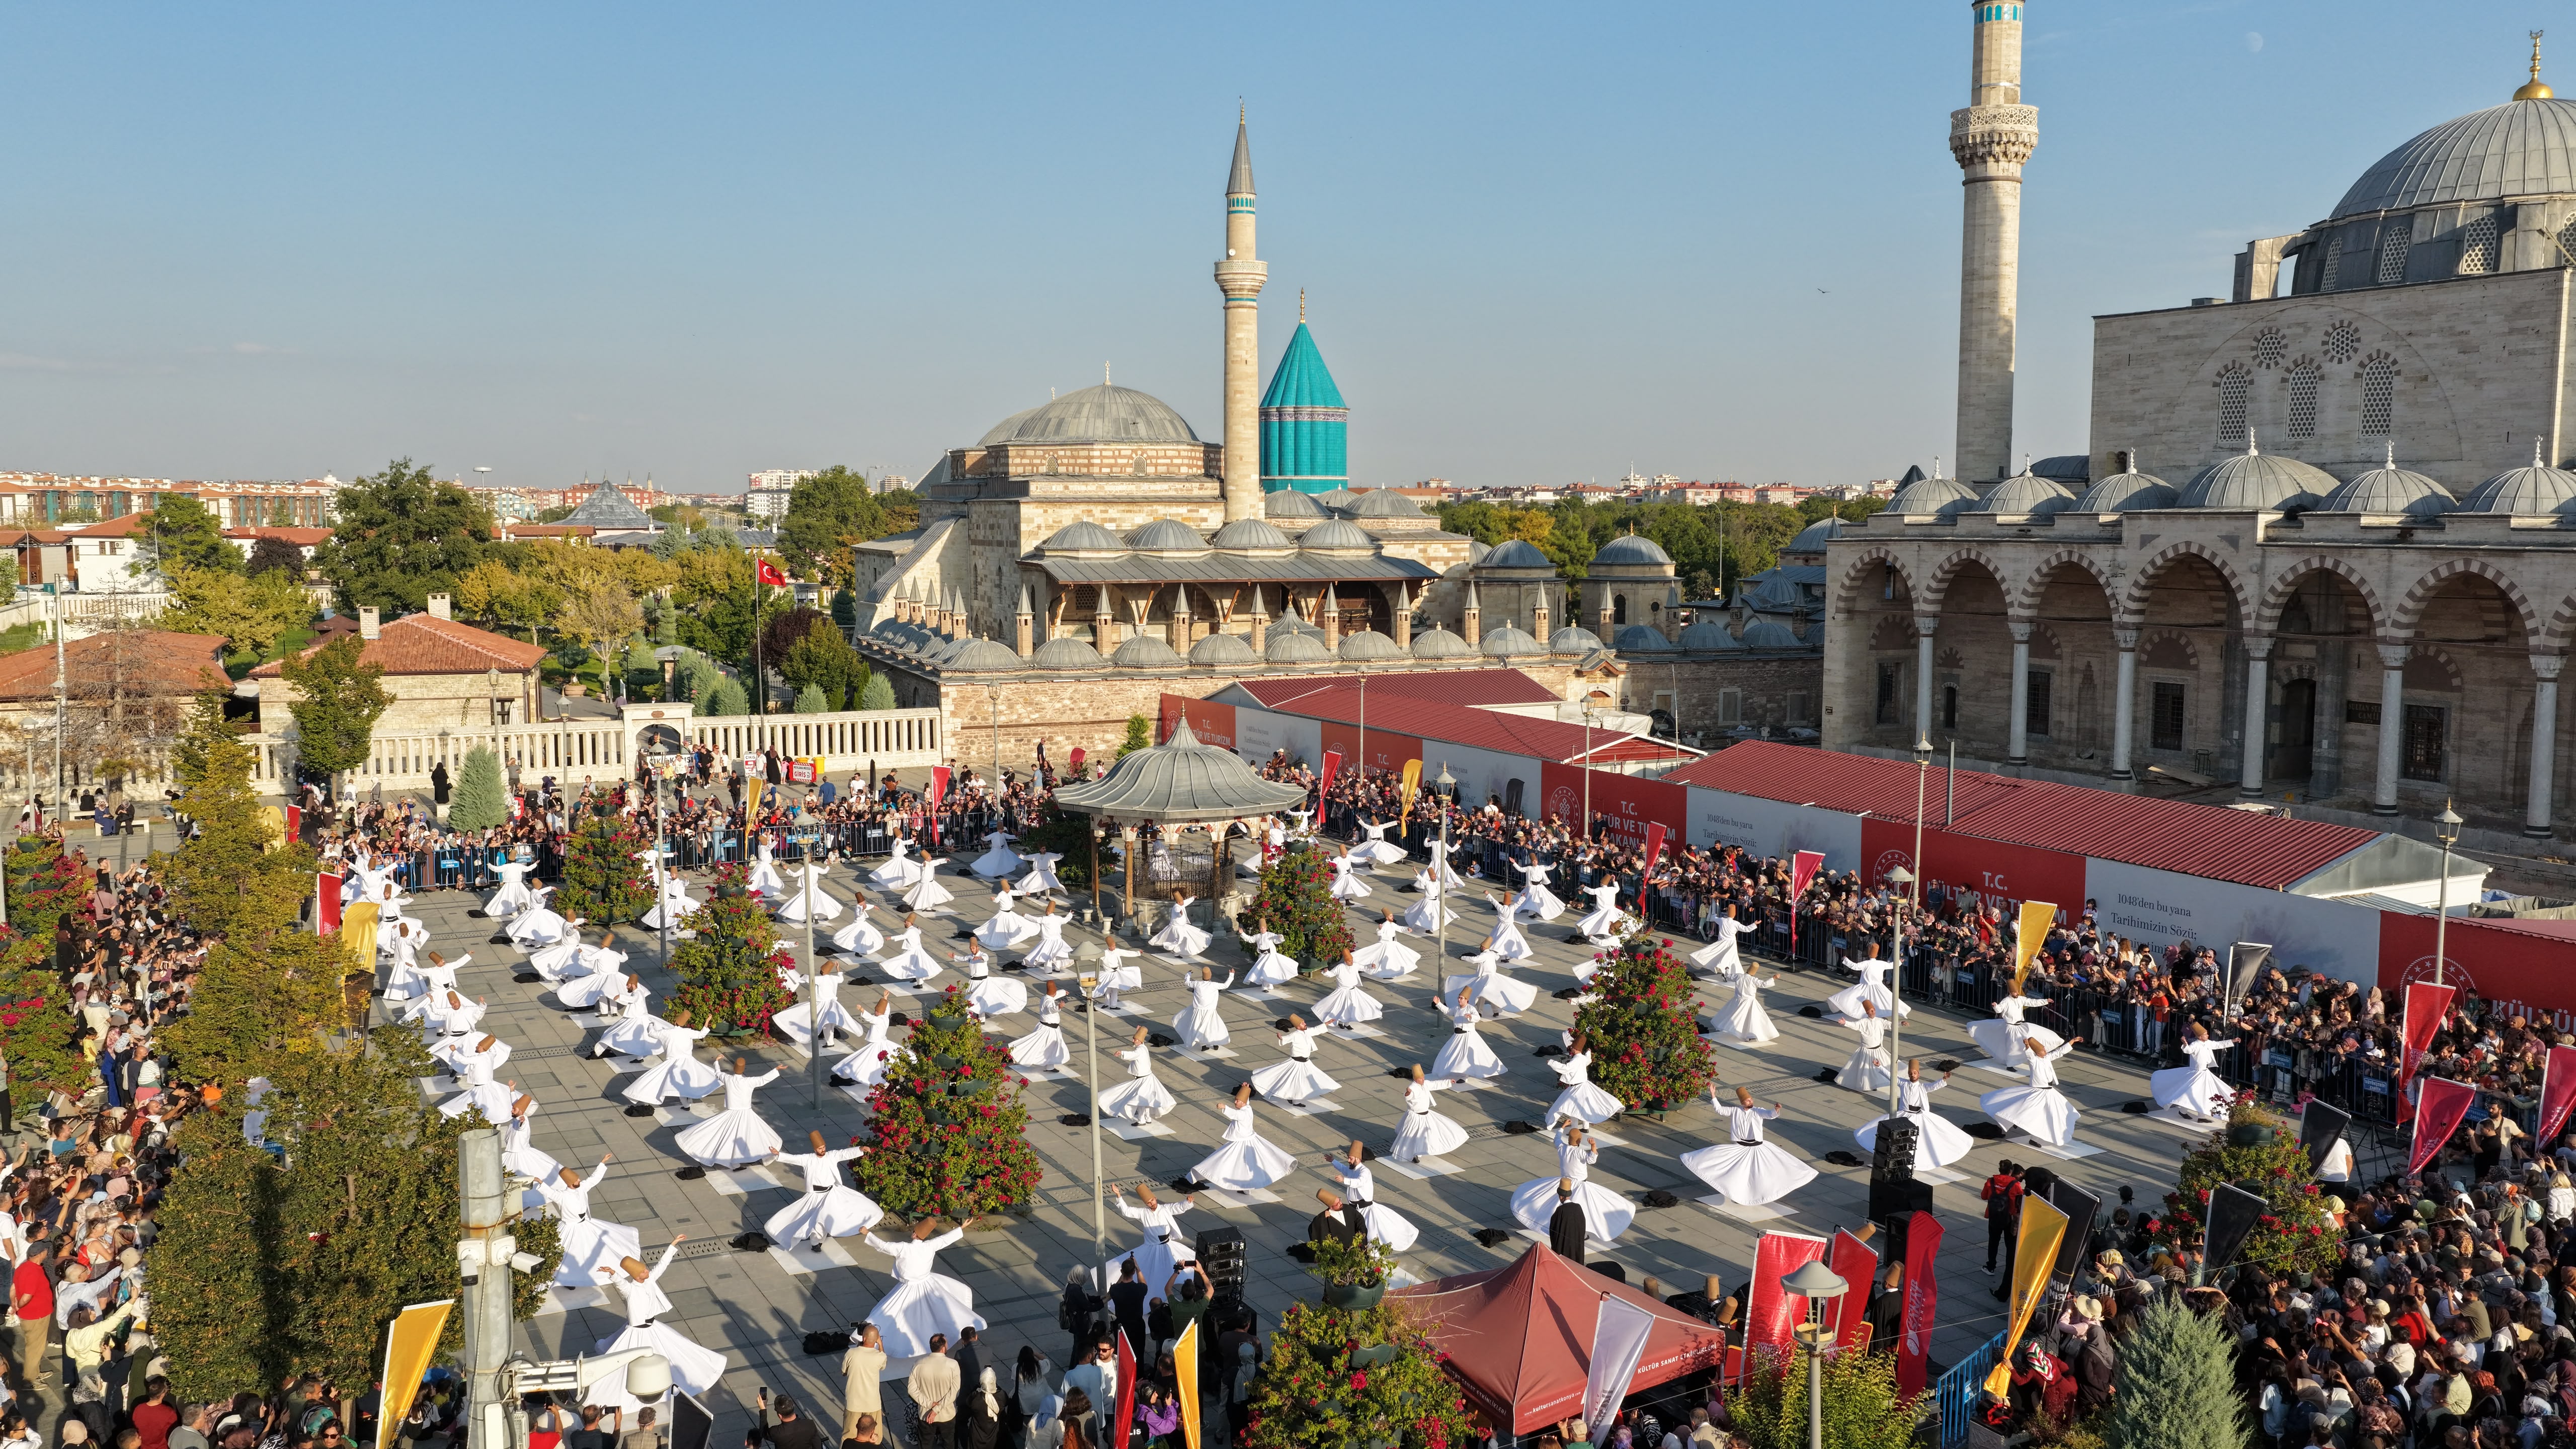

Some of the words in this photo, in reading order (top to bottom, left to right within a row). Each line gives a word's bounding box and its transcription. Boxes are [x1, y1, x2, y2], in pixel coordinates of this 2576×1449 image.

[1202, 719, 1211, 729] T.C.
[1204, 732, 1210, 741] VE
[1211, 733, 1231, 746] TURİZM
[1352, 761, 1378, 776] KÜTÜR
[1378, 753, 1389, 765] T.C.
[1621, 801, 1637, 816] T.C.
[1585, 809, 1621, 830] KÜTÜR
[1623, 818, 1635, 833] VE
[1707, 814, 1730, 825] 1048'den
[1731, 818, 1738, 827] bu
[1739, 821, 1753, 830] yana
[1703, 829, 1738, 844] Tarihimizin
[1740, 836, 1757, 848] Sözü;
[1983, 871, 2007, 891] T.C.
[2118, 894, 2154, 910] 1048'den
[2157, 901, 2167, 912] bu
[2169, 906, 2191, 917] yana
[2111, 912, 2167, 933] Tarihimizin
[2170, 924, 2197, 941] Sözü;
[1638, 1362, 1659, 1374] KÜLTÜR
[1661, 1355, 1678, 1366] SANAT
[1680, 1342, 1717, 1360] ETKİNLİKLERİ
[1444, 1365, 1461, 1381] KÜLTÜR
[1462, 1378, 1476, 1393] SANAT
[1476, 1390, 1506, 1416] ETKİNLİKLERİ
[1524, 1391, 1581, 1416] www.kultursanatkonya.com
